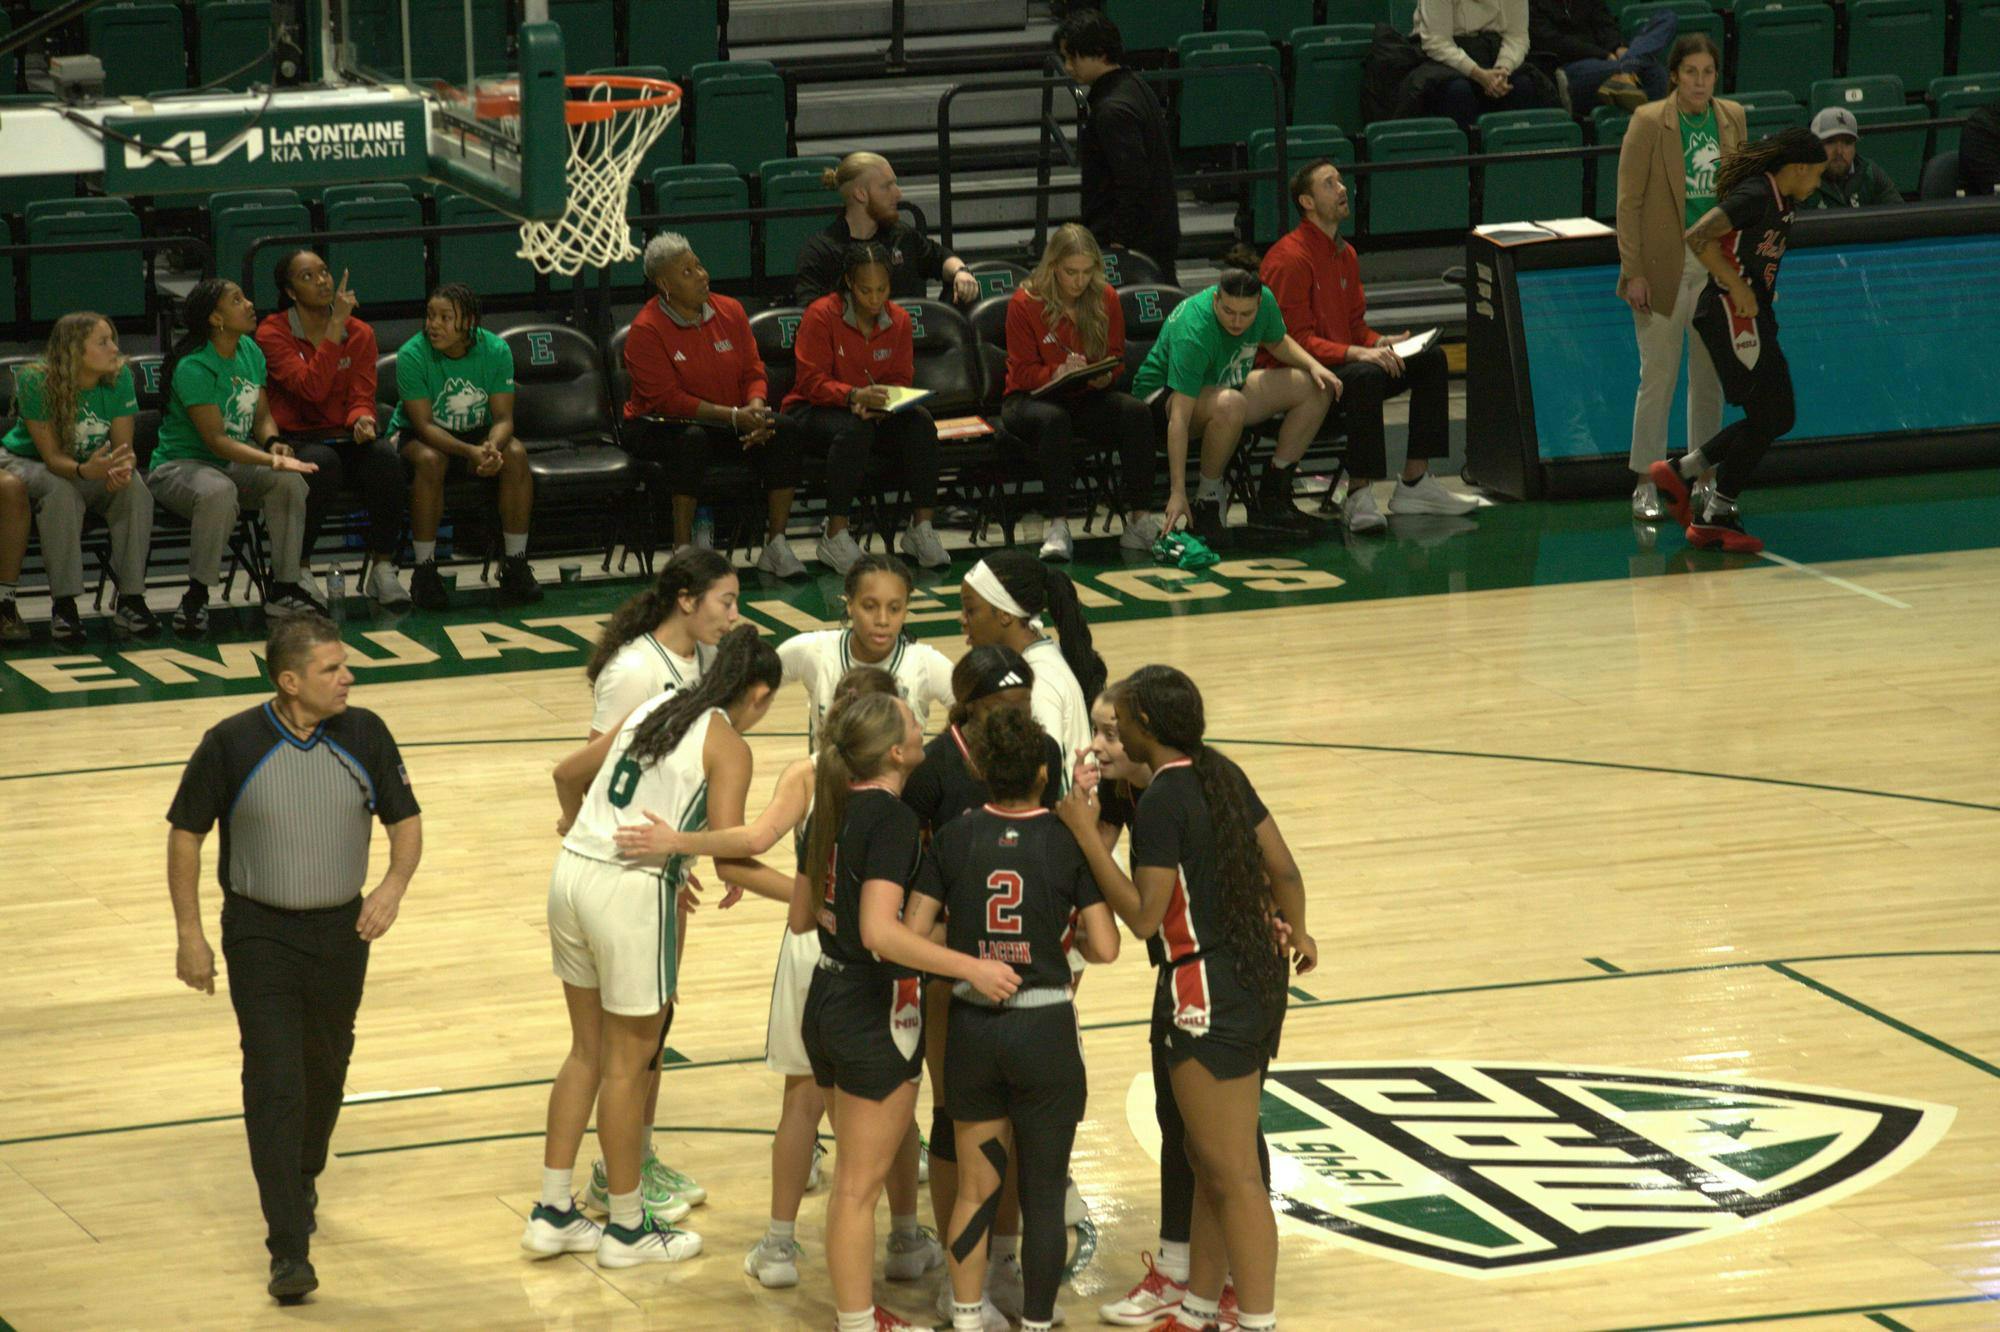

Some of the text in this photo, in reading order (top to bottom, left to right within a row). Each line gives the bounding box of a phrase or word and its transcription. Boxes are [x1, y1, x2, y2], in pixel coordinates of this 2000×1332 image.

[271, 141, 406, 163] KIA YPSILANTI
[1135, 290, 1163, 323] E
[527, 332, 555, 365] E
[986, 869, 1023, 934] 2
[894, 1015, 919, 1030] NIU
[1177, 1015, 1206, 1027] NIU
[1271, 1141, 1403, 1188] 1946
[1316, 1067, 1744, 1233] MAC
